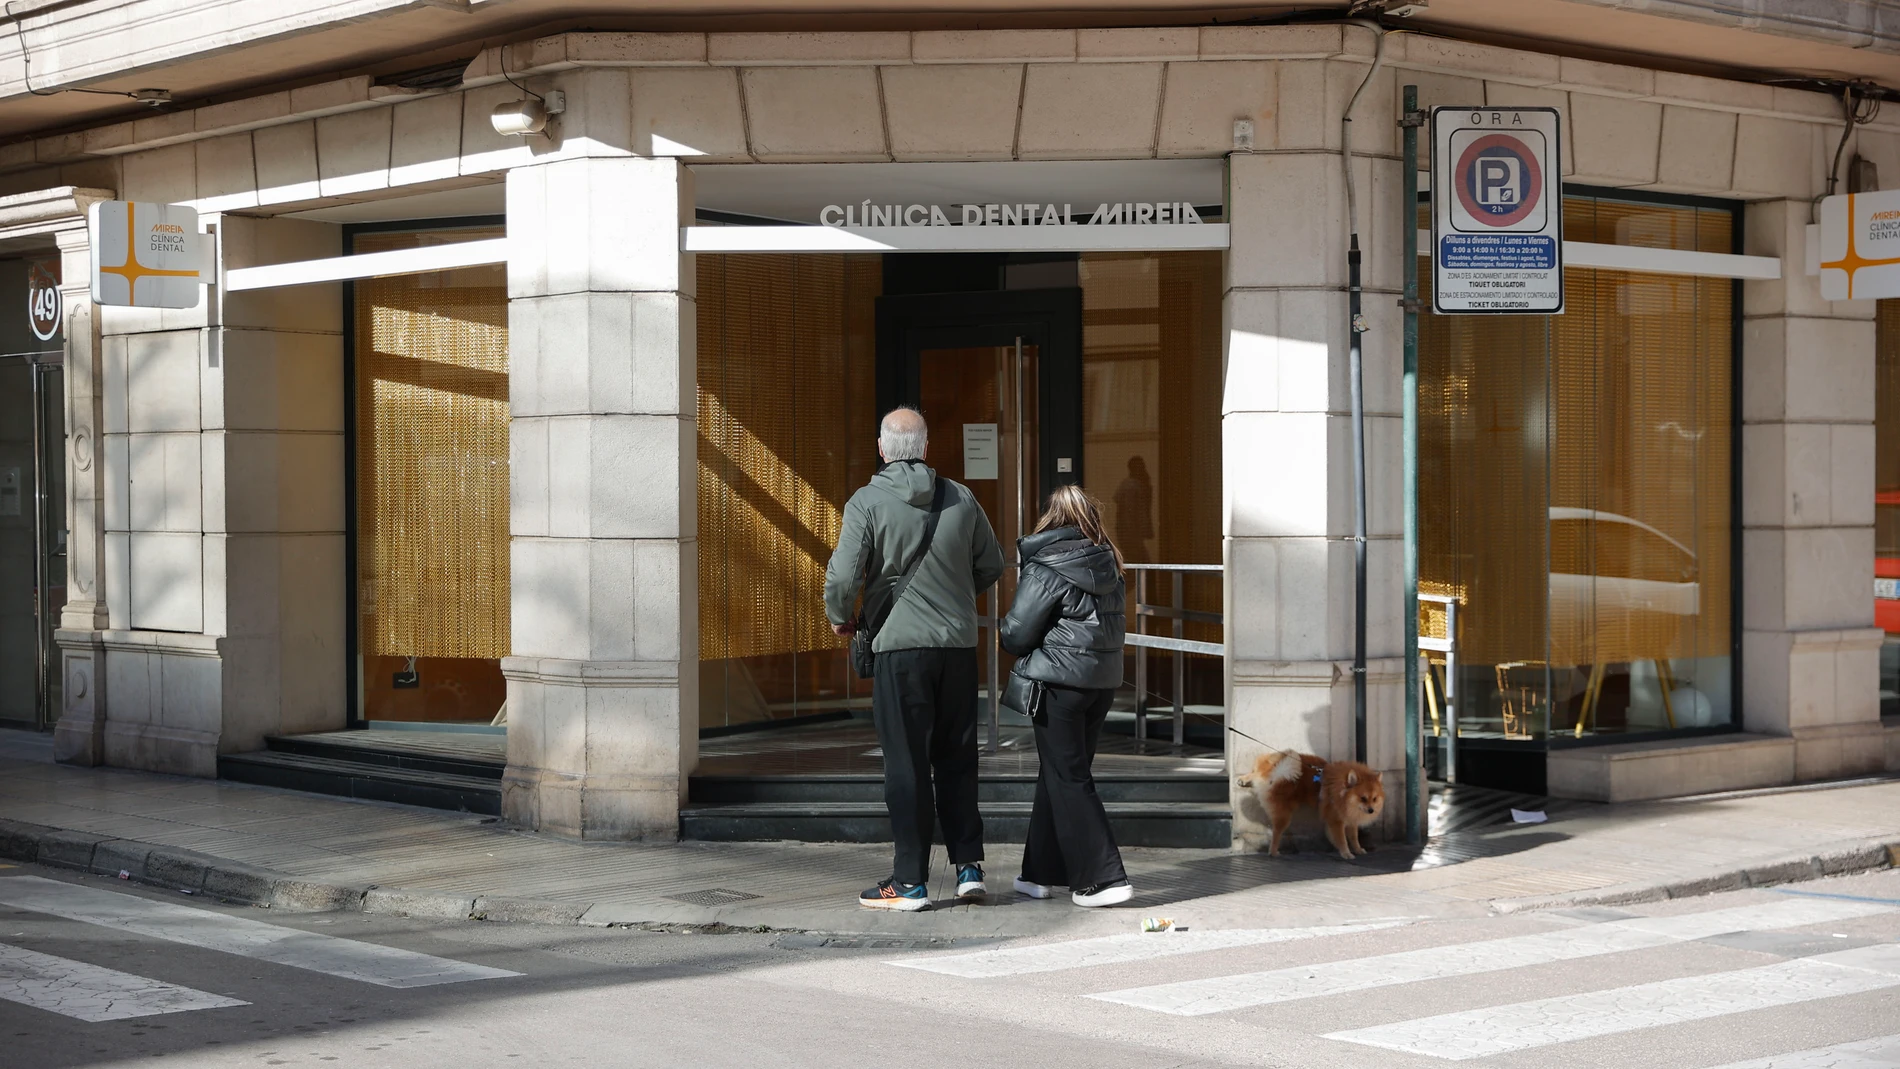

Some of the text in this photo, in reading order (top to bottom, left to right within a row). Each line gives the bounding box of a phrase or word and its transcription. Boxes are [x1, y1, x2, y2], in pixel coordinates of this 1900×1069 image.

[1471, 112, 1522, 125] ORA
[819, 198, 1204, 227] CLÍNICA DENTAL MIREIA
[151, 223, 184, 234] MIREIA
[151, 233, 184, 243] CLÍNICA
[1446, 235, 1466, 244] Dilluns
[1472, 236, 1500, 244] divendres
[1528, 237, 1549, 245] Viernes
[151, 243, 185, 252] DENTAL
[34, 287, 56, 322] 49
